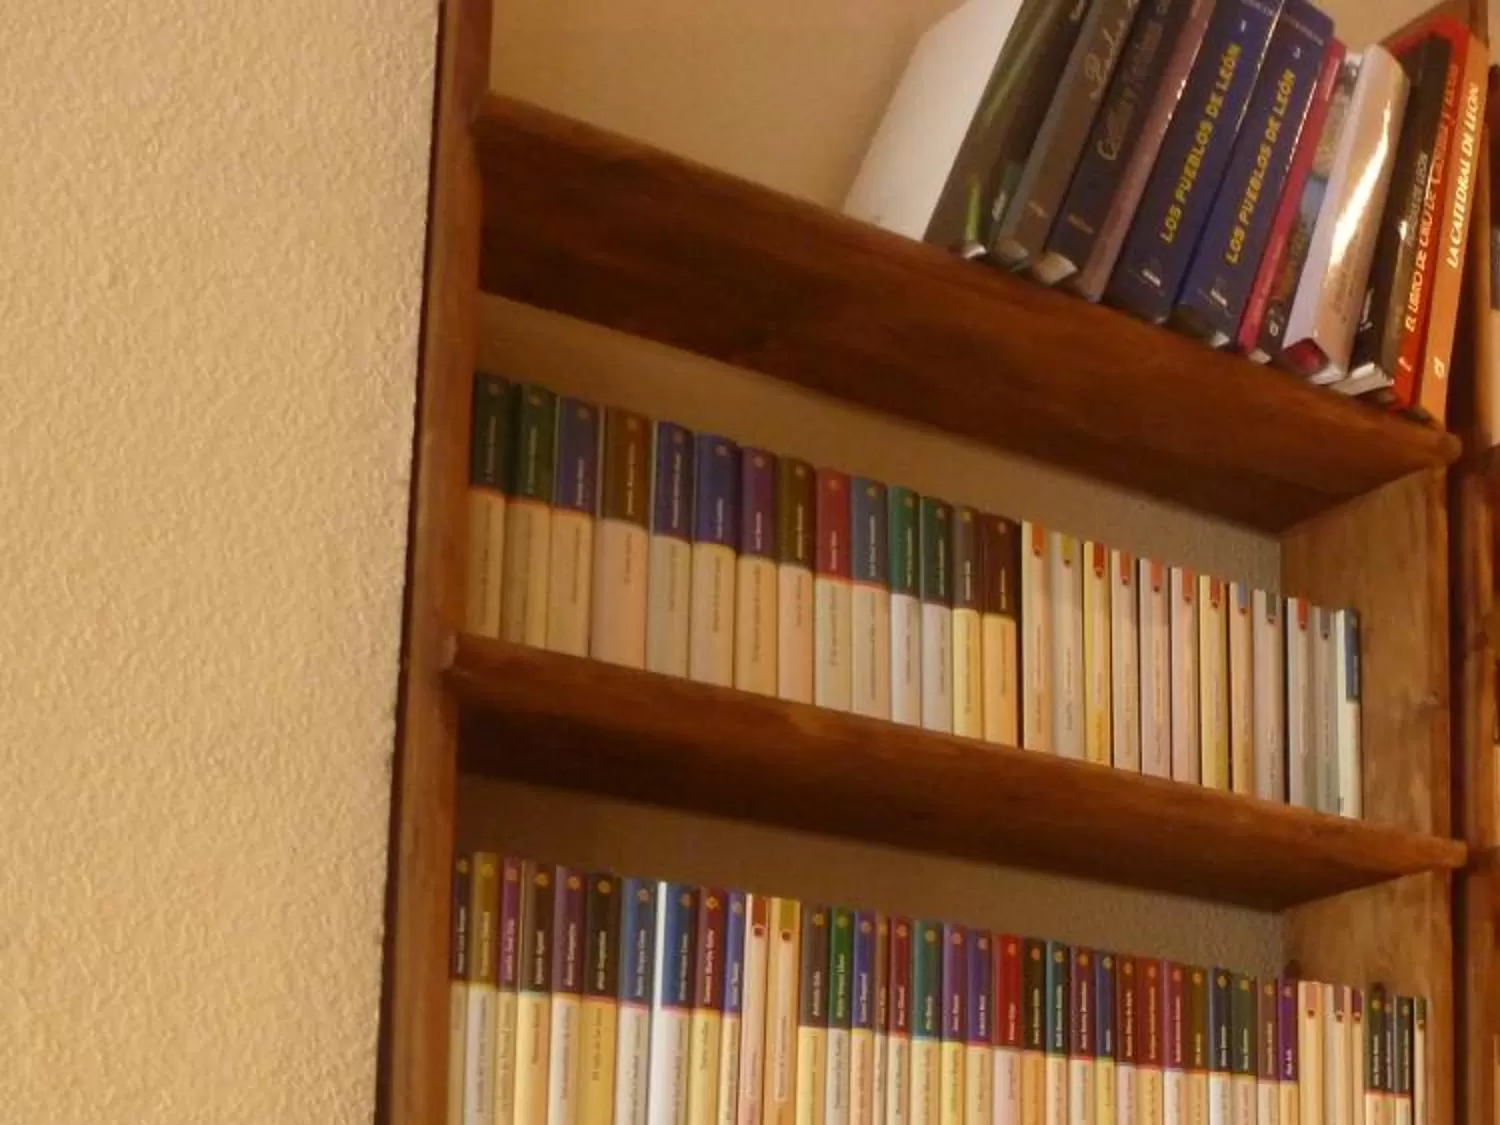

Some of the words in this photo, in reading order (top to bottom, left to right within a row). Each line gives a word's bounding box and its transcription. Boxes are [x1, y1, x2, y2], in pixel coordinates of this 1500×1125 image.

[1272, 68, 1297, 116] LEÓN
[1265, 115, 1282, 144] DE
[1160, 203, 1182, 244] LOS
[1173, 119, 1213, 204] PUEBLOS
[1205, 90, 1224, 119] DE
[1238, 143, 1273, 226] PUEBLOS
[1224, 225, 1246, 266] LOS
[1446, 250, 1460, 269] LA
